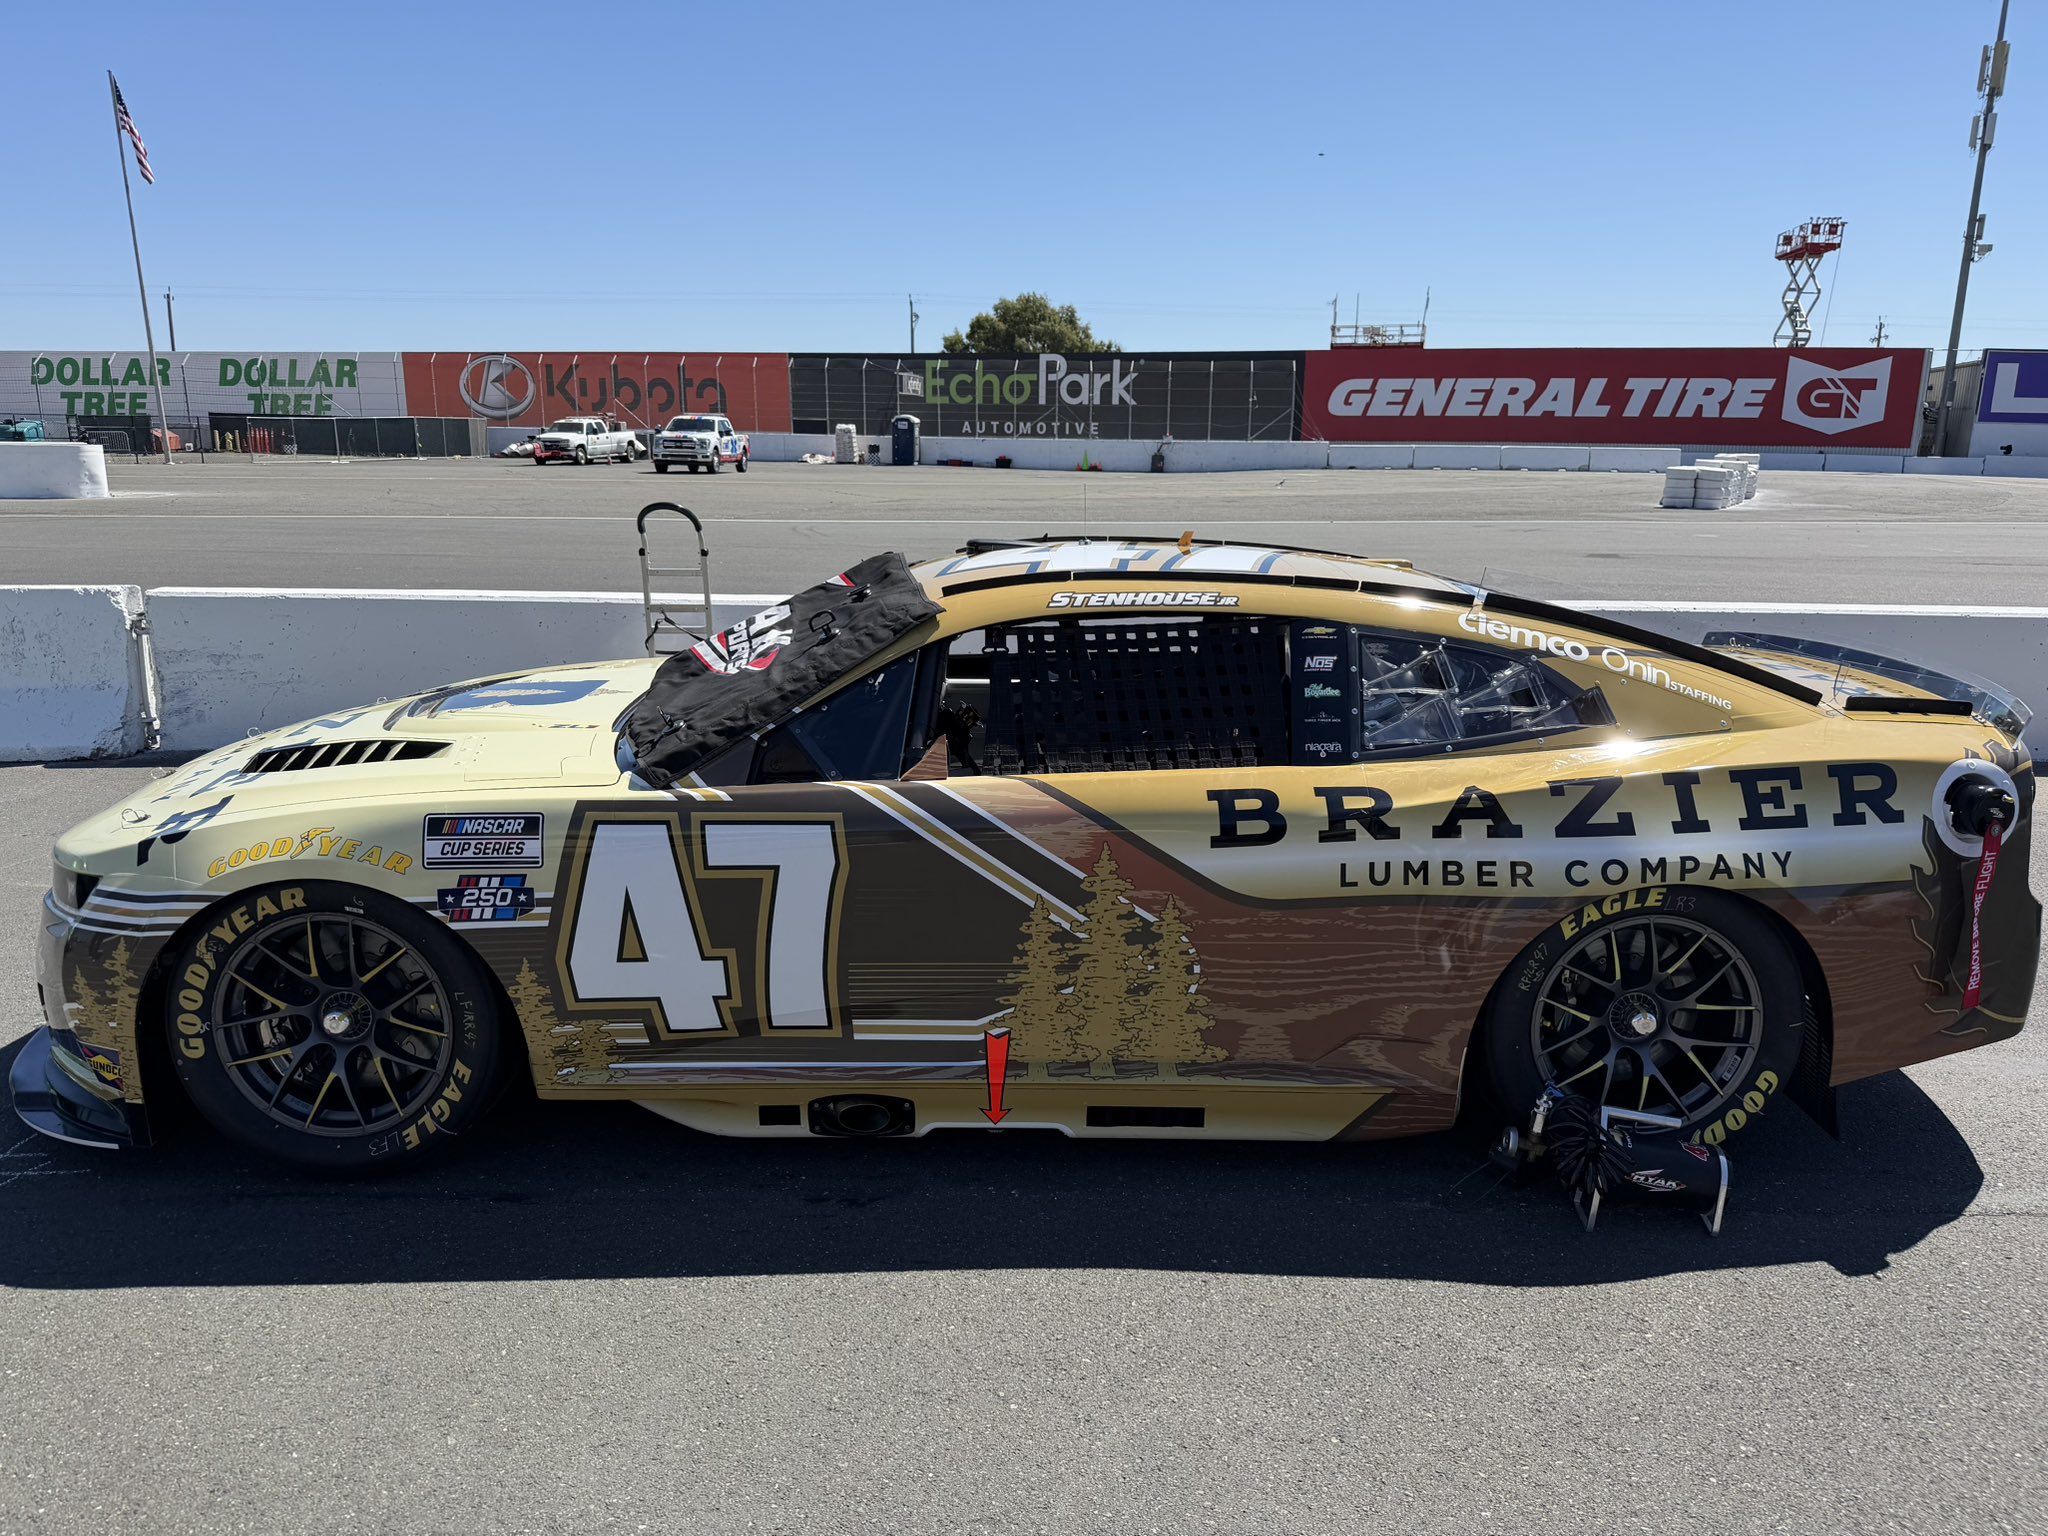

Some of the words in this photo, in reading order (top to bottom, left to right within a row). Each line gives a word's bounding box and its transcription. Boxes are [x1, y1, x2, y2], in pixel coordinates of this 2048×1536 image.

[31, 357, 171, 386] DOLLAR
[218, 357, 358, 388] DOLLAR
[925, 353, 1138, 406] EchoPark
[545, 363, 727, 413] Kubota
[1327, 377, 1611, 418] GENERAL
[1624, 377, 1777, 418] TIRE
[60, 391, 147, 416] TREE
[247, 392, 334, 417] TREE
[962, 420, 1100, 436] AUTOMOTIVE
[1046, 592, 1221, 608] STENHOUSE
[1304, 656, 1337, 668] NOS
[1670, 681, 1733, 710] STAFFING
[1305, 743, 1342, 758] niagara
[1206, 762, 1905, 848] BRAZIER
[461, 819, 525, 834] NASCAR
[207, 834, 413, 878] GOODYEAR
[440, 842, 471, 856] CUP
[473, 841, 525, 856] SERIES
[1339, 859, 1535, 888] LUMBER
[1565, 851, 1793, 887] COMPANY
[462, 888, 513, 907] 250
[564, 819, 841, 1033] 47
[1559, 887, 1668, 941] EAGLE
[1967, 940, 1981, 991] REMOVE
[1976, 850, 1998, 890] FLIGHT
[402, 1058, 473, 1151] EAGLE
